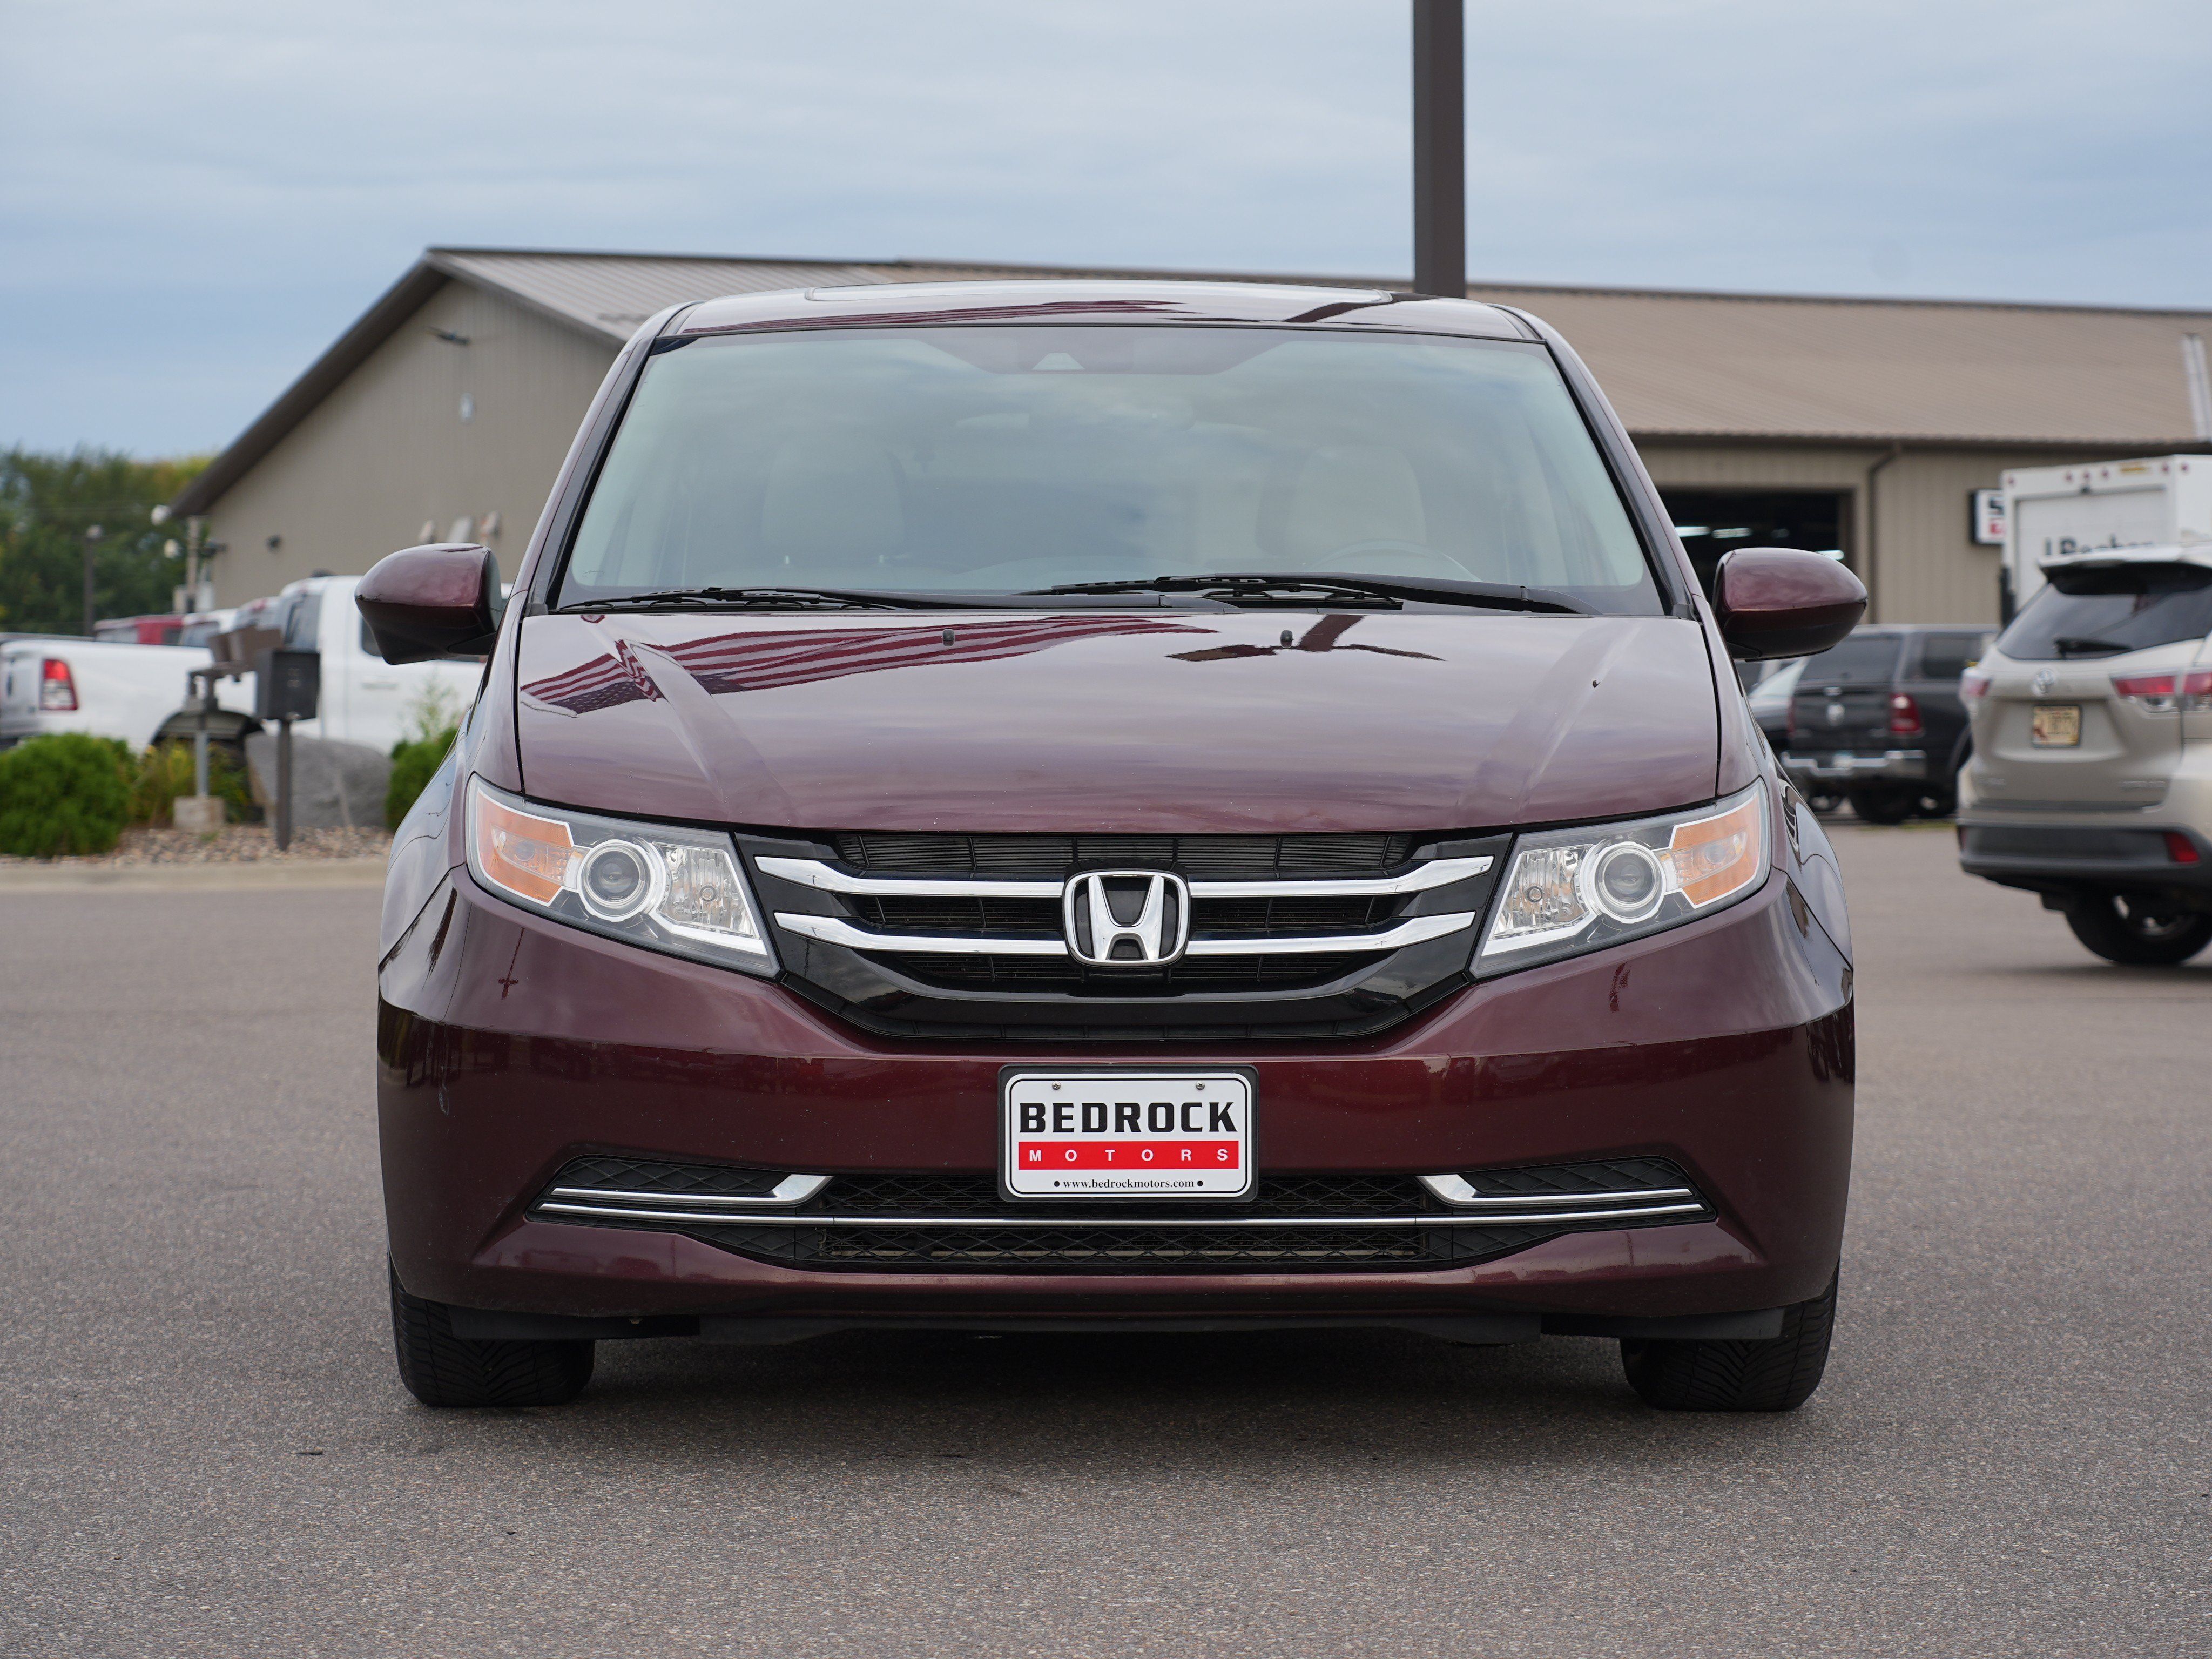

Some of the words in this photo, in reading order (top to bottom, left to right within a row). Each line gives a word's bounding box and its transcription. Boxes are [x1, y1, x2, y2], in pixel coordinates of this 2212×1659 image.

[1020, 1102, 1237, 1133] BEDROCK
[1029, 1149, 1229, 1162] MOTORS
[1063, 1179, 1195, 1188] www.bedrockmotors.com
